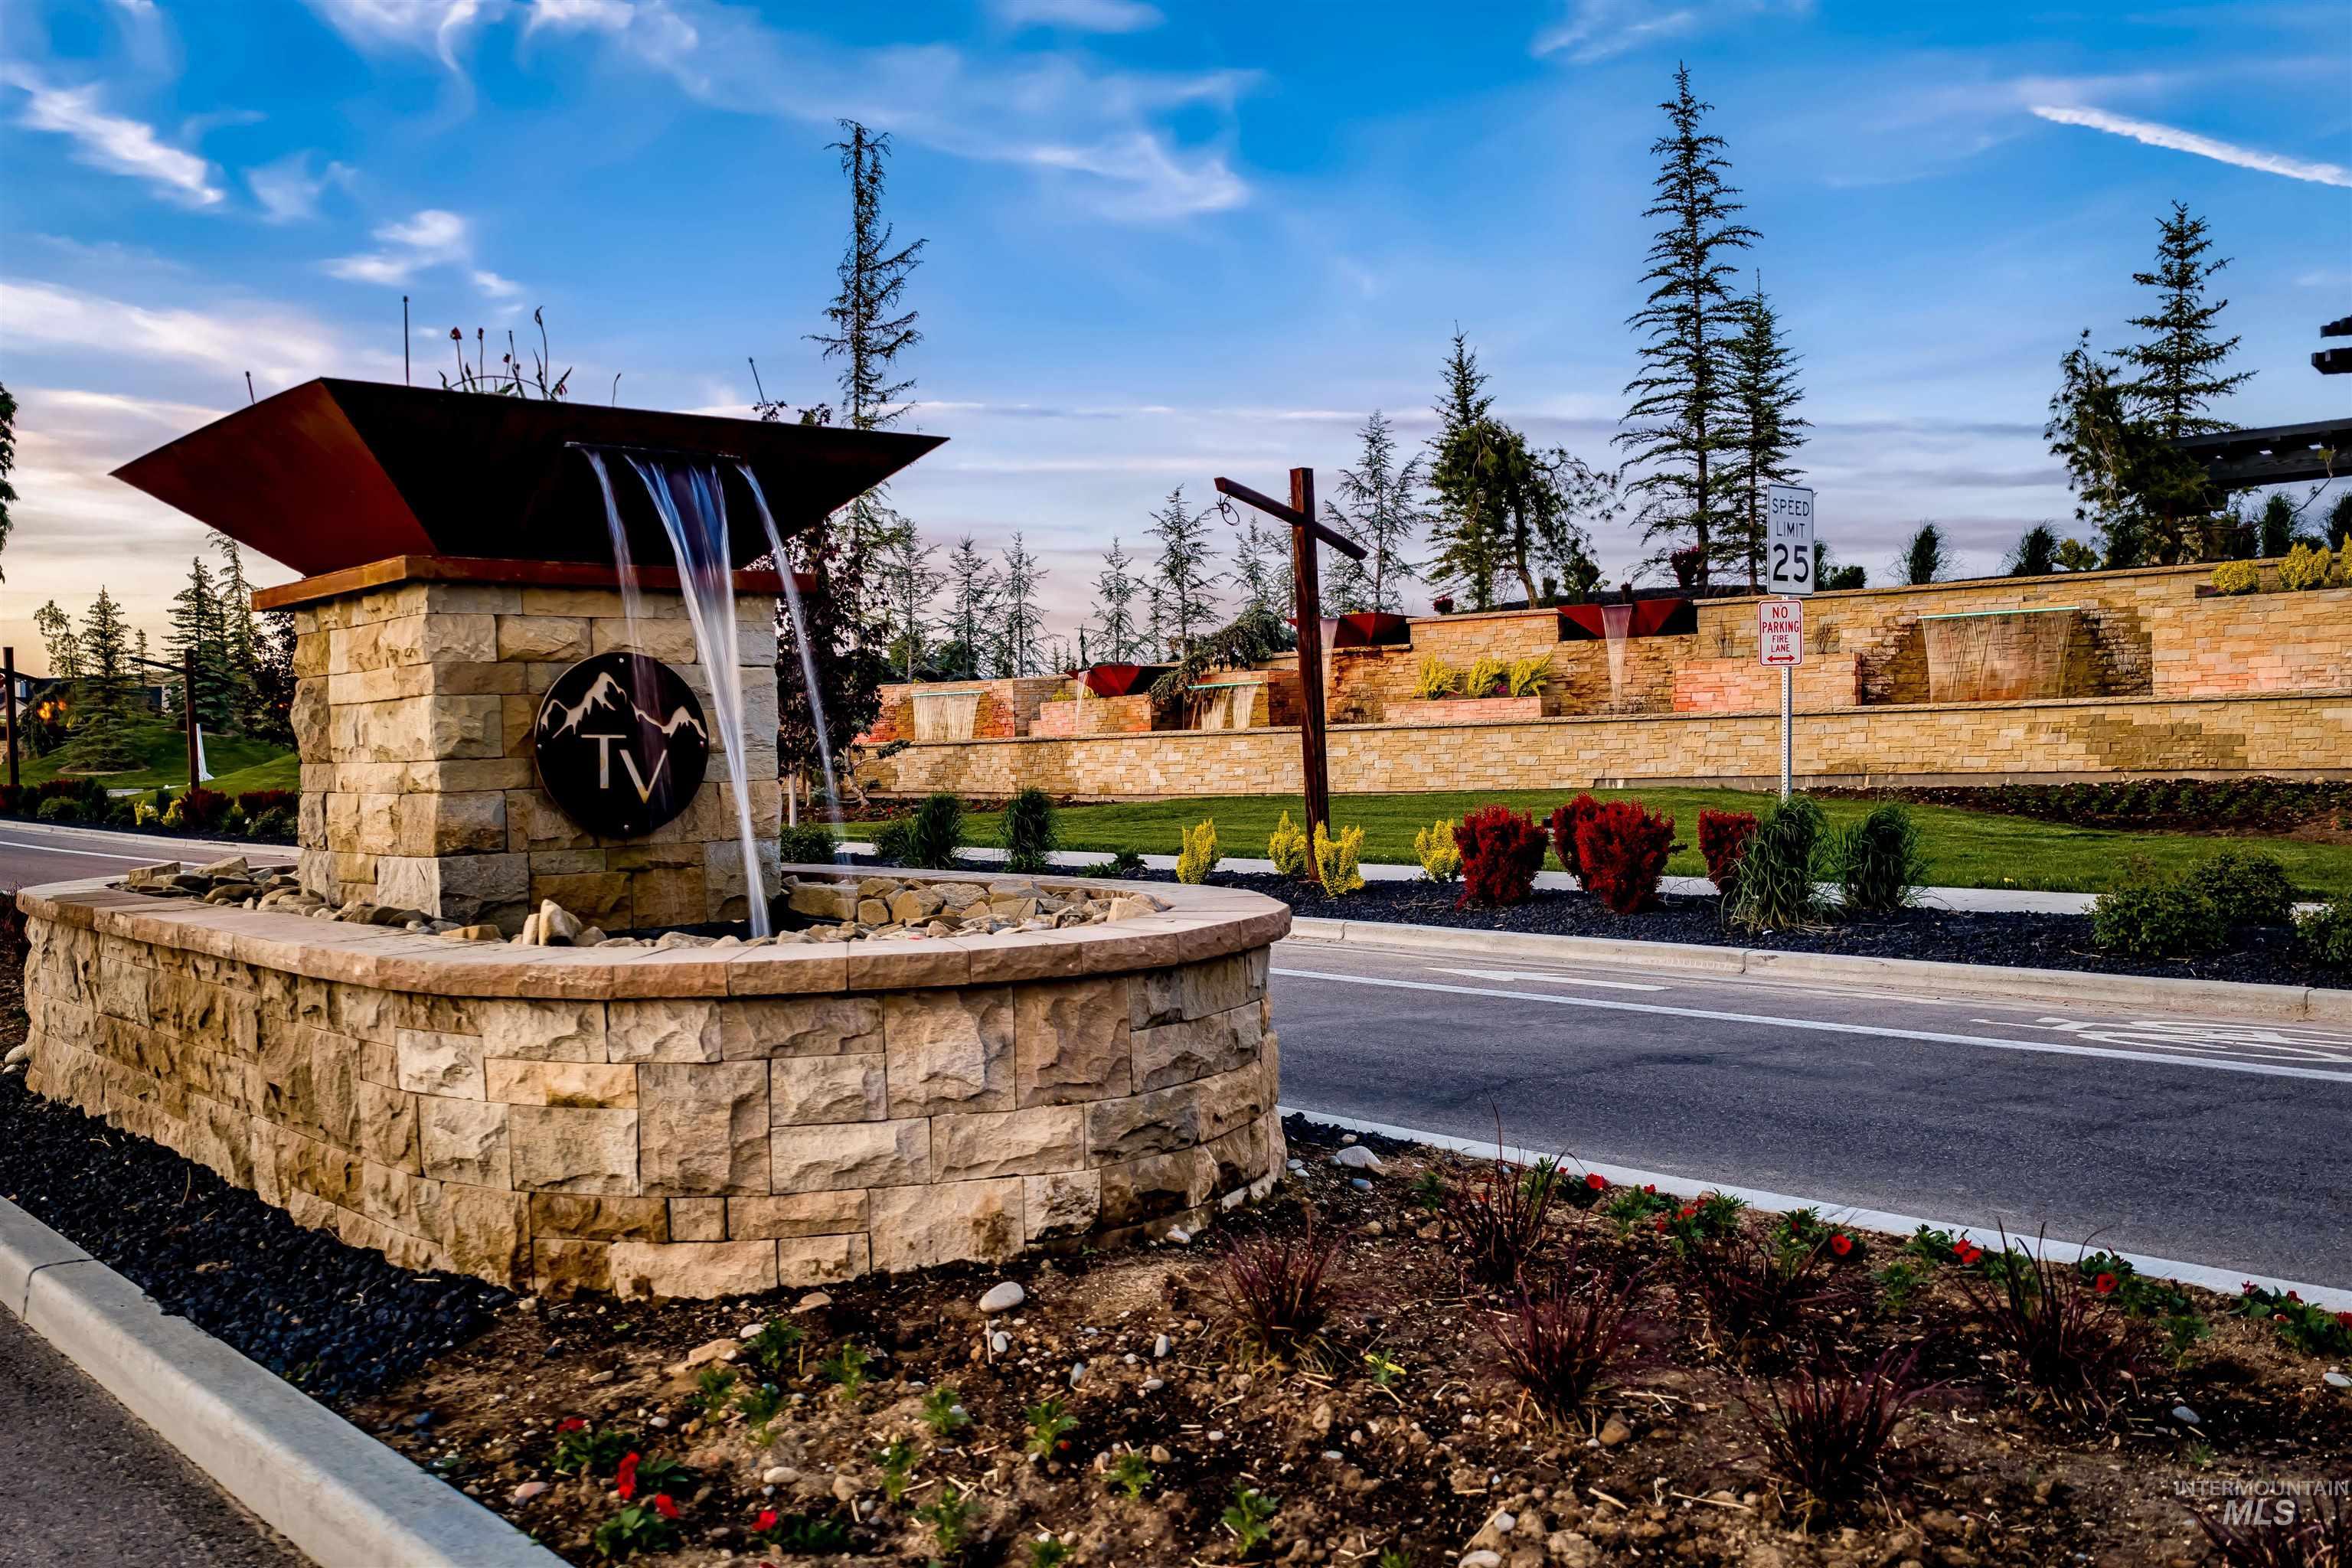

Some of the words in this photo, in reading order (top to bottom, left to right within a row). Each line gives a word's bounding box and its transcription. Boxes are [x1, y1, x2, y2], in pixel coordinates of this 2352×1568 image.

[1772, 498, 1809, 517] SPEED
[1776, 521, 1805, 538] LIMIT
[1773, 543, 1809, 583] 25
[1772, 607, 1788, 619] NO
[1762, 621, 1799, 633] PARKING
[1772, 635, 1789, 643] FIRE
[1771, 644, 1790, 652] LANE
